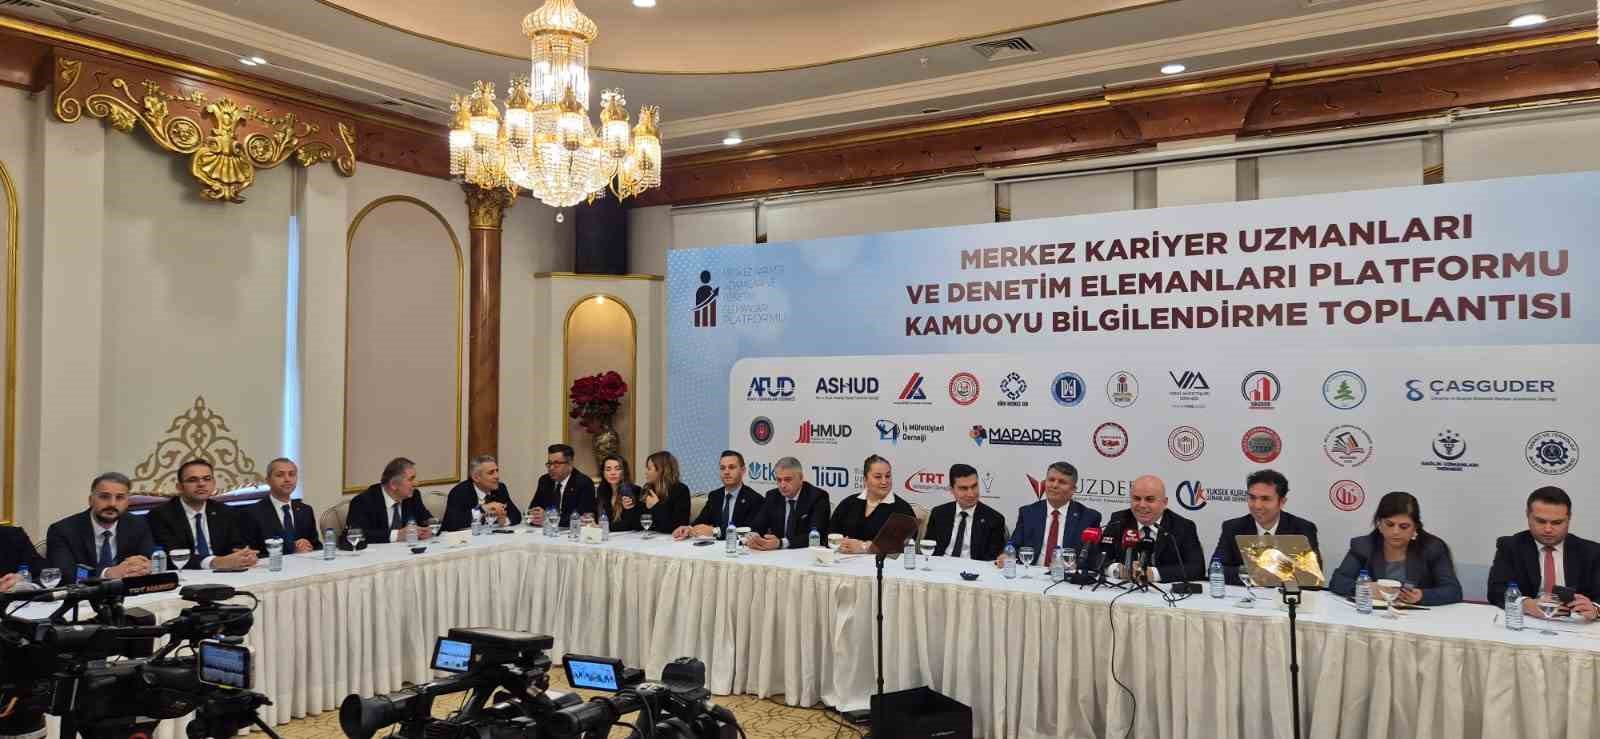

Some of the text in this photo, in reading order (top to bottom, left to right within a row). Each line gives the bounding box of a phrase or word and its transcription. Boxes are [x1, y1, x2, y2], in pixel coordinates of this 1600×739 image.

[961, 214, 1473, 270] MERKEZ KARİYER UZMANLARI
[906, 249, 1569, 304] VE DENETİM ELEMANLARI PLATFORMU
[905, 292, 1572, 337] KAMUOYU BİLGİLENDİRME TOPLANTISI
[815, 377, 879, 394] ASHUD
[1429, 380, 1556, 396] ÇASGUDER
[811, 423, 852, 438] HMUD
[988, 427, 1062, 442] MAPADER
[918, 472, 944, 484] TRT
